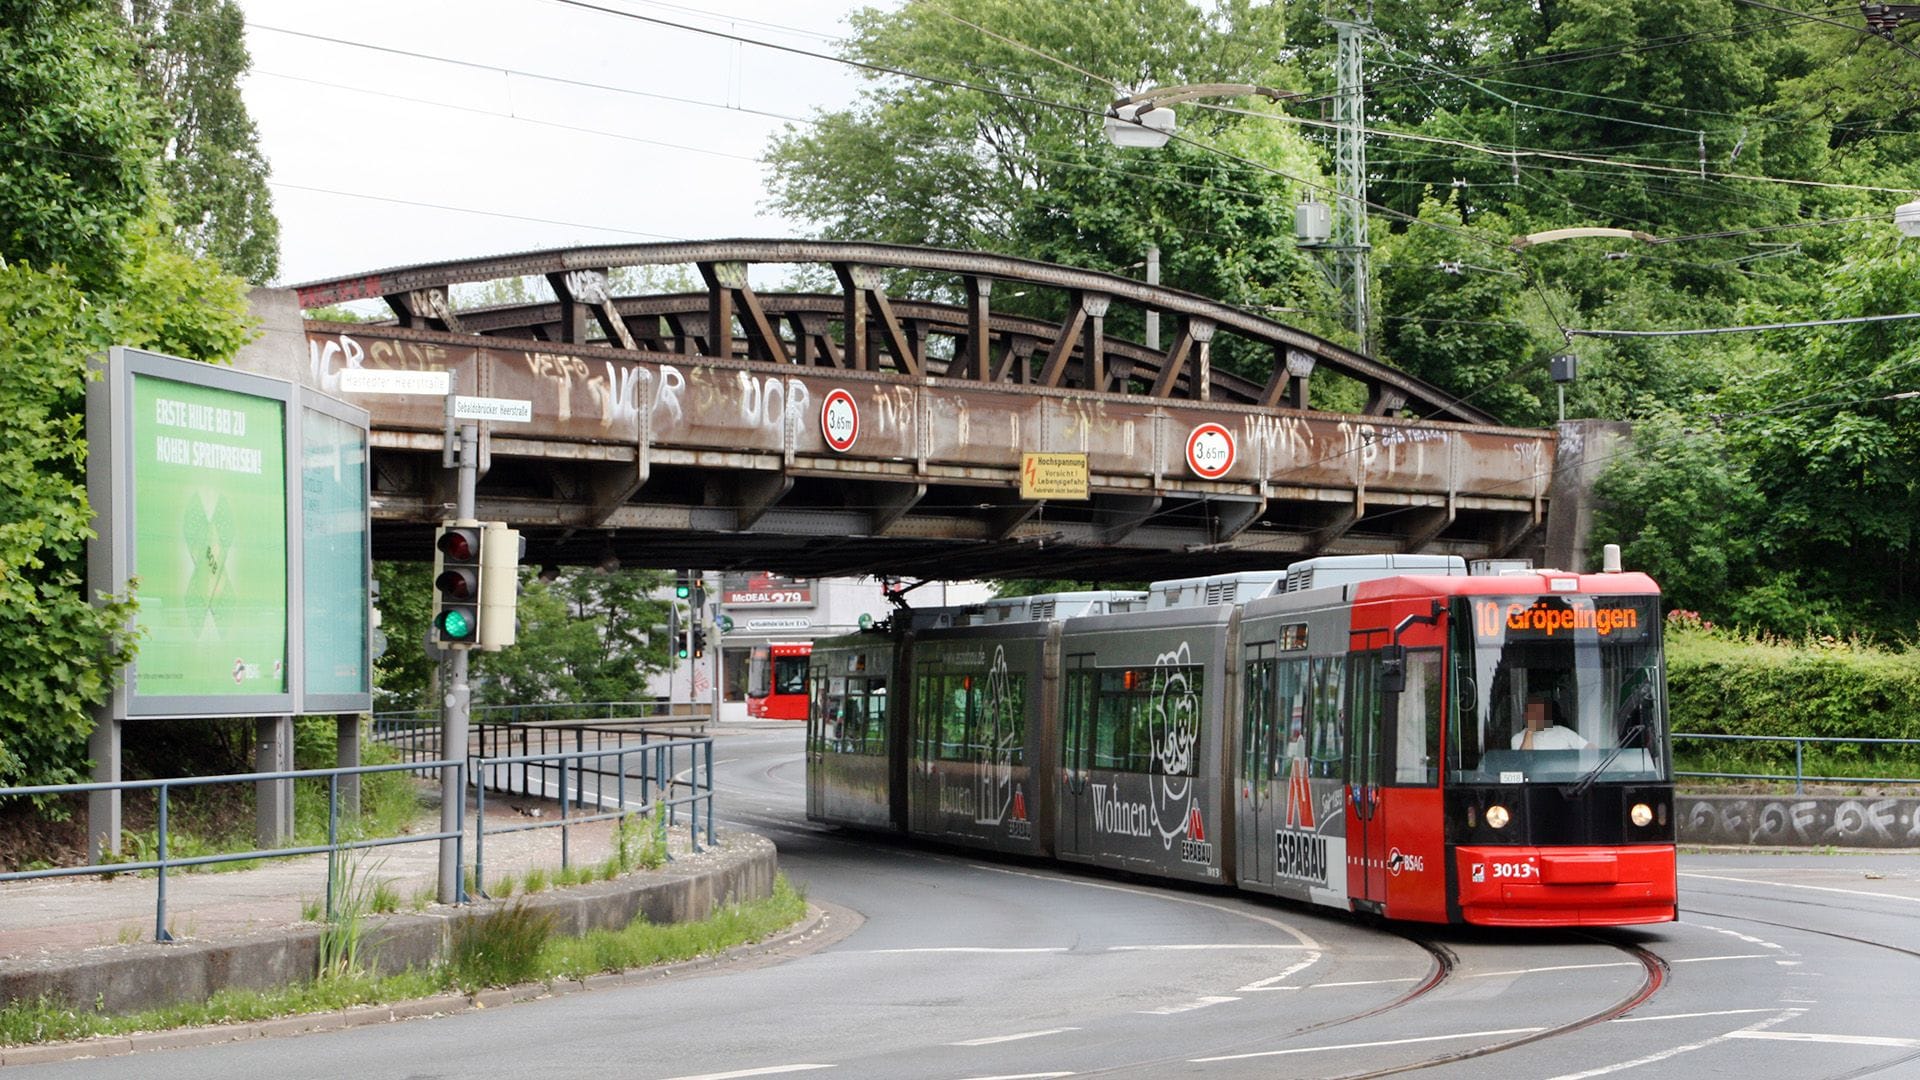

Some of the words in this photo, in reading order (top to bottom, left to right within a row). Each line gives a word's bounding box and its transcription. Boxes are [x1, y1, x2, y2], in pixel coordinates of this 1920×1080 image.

[155, 399, 188, 425] ERSTE
[189, 403, 215, 431] HILFE
[216, 408, 232, 434] BEI
[232, 411, 246, 437] ZU
[156, 435, 190, 464] HOHEN
[192, 440, 262, 474] SPRITPREISEN!
[1037, 456, 1085, 468] Hochspannung
[732, 593, 770, 602] McDEAL
[1476, 602, 1499, 636] 10
[1507, 603, 1637, 635] Gröpelingen
[1091, 774, 1151, 837] Wohnen.
[1276, 830, 1327, 882] ESPABAU
[1404, 854, 1424, 872] BSAG
[1492, 863, 1531, 878] 3013
